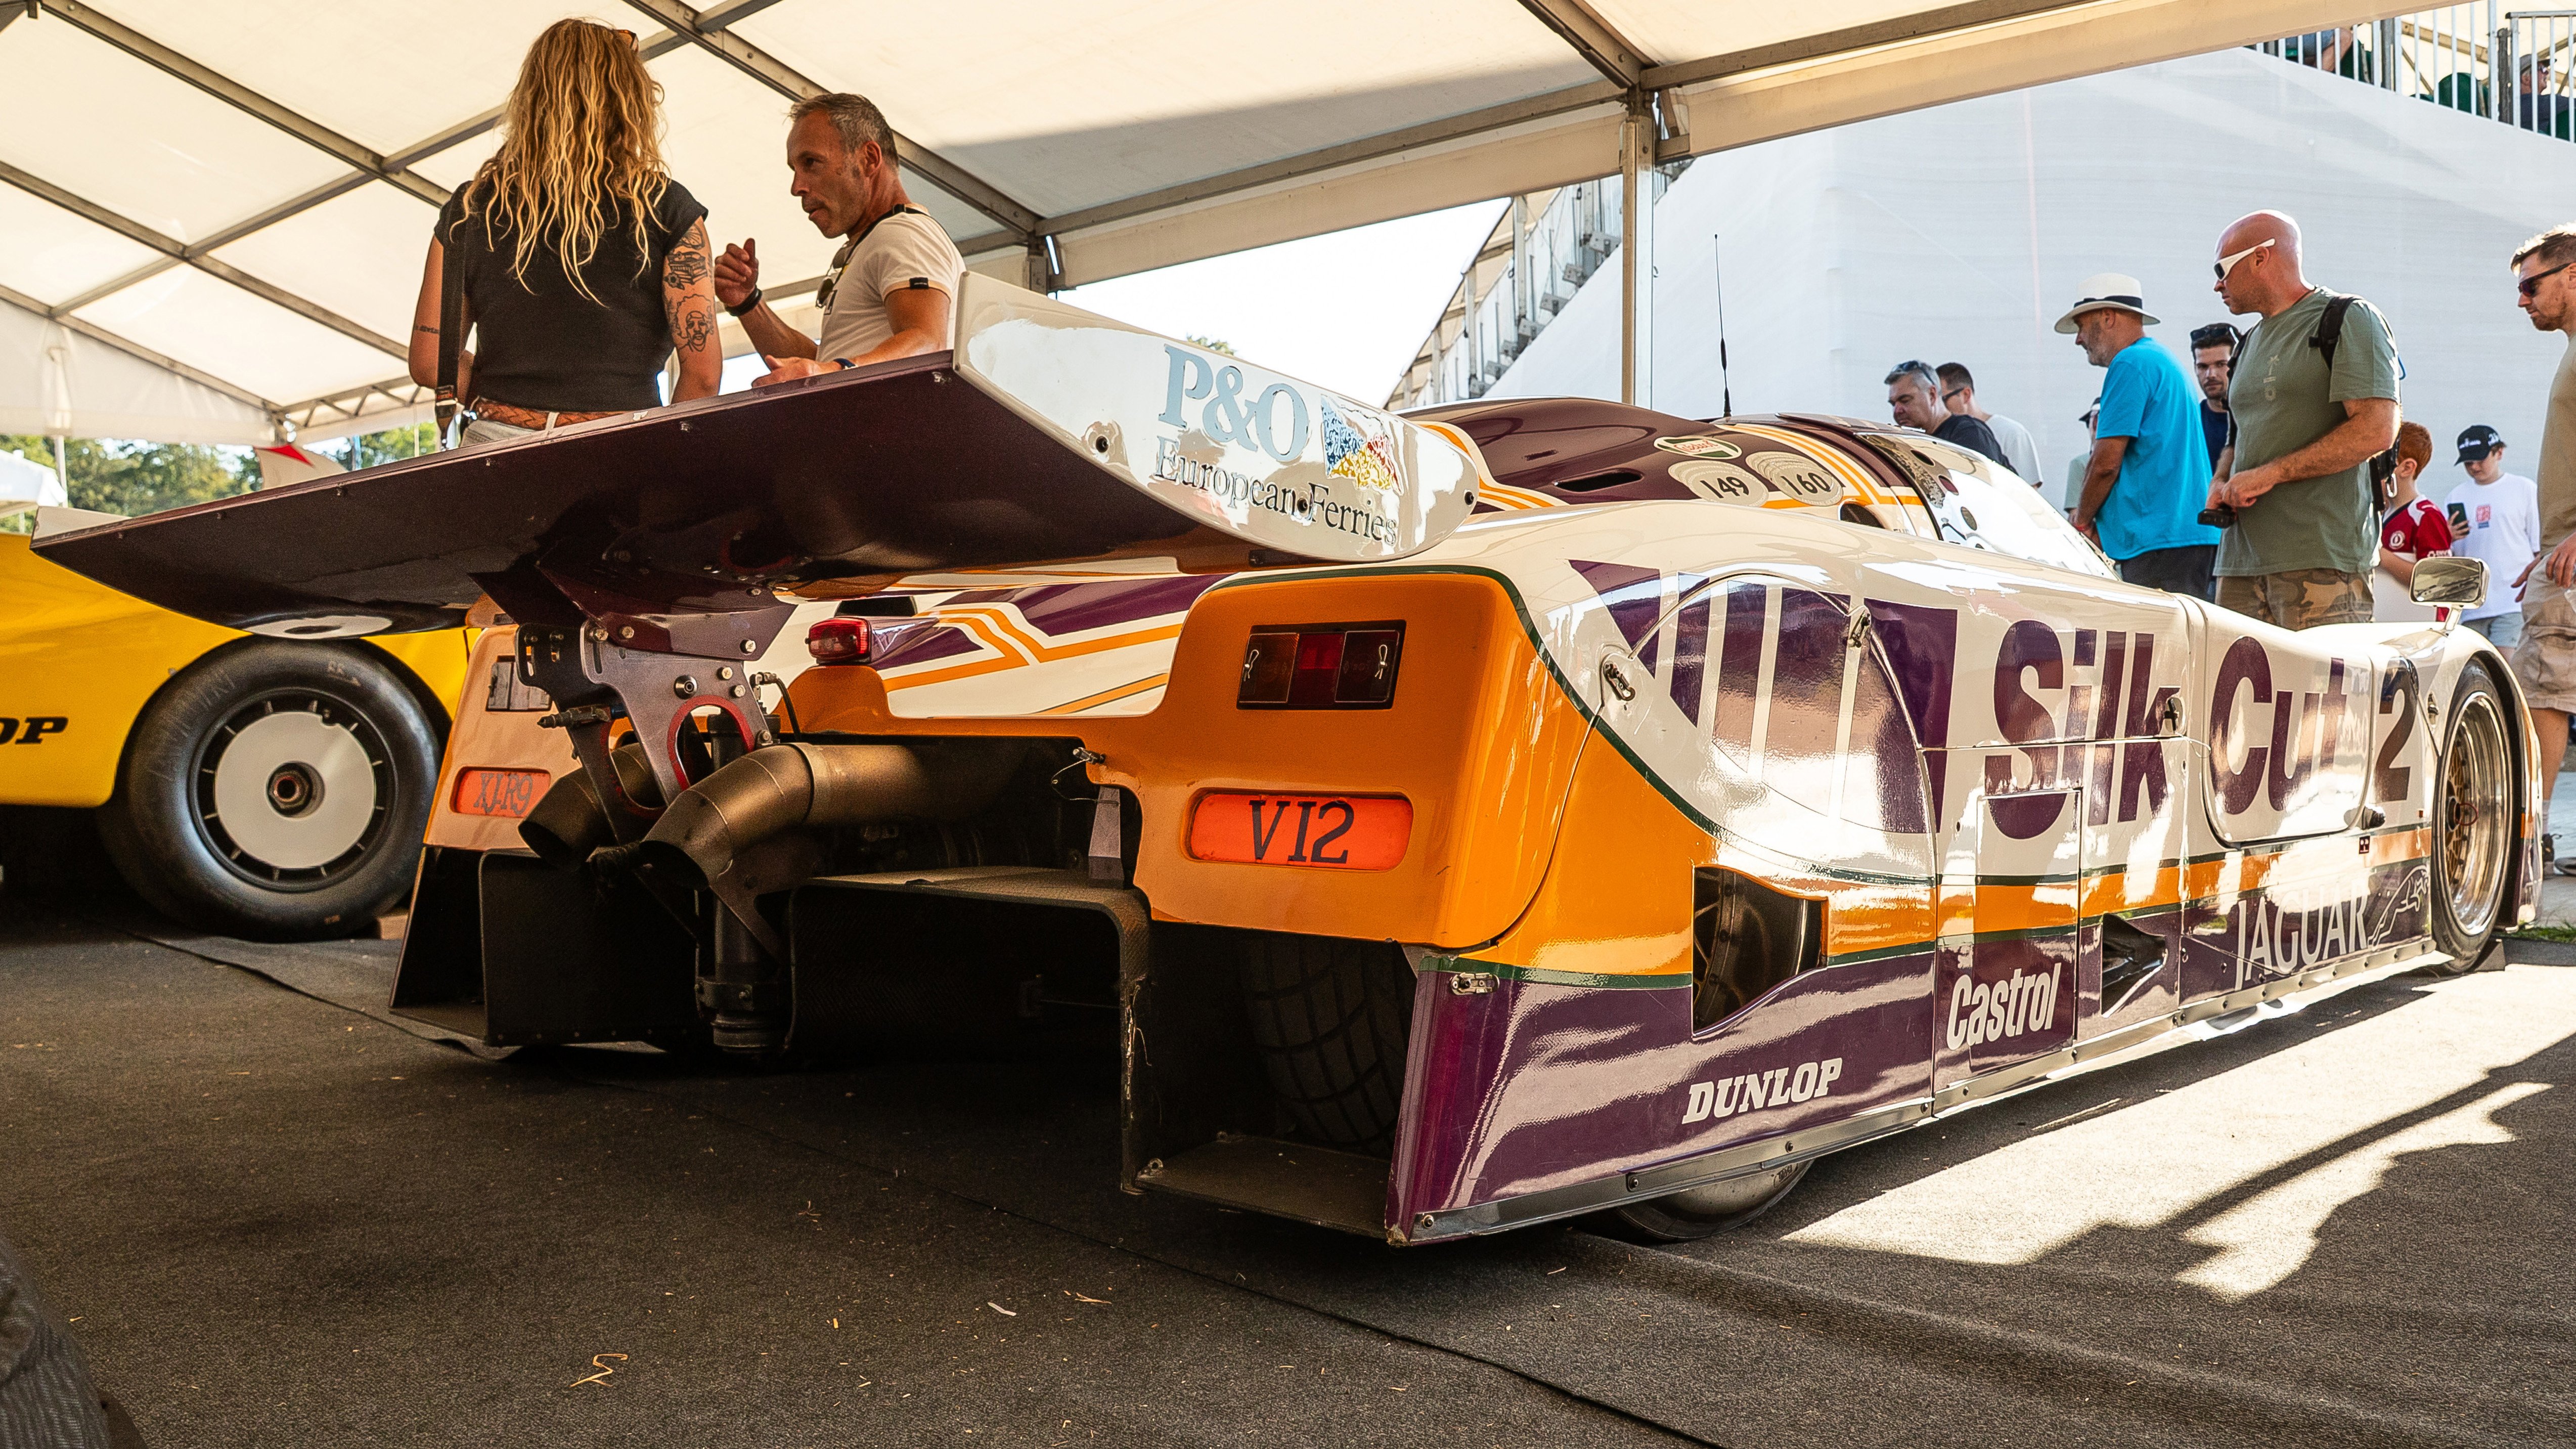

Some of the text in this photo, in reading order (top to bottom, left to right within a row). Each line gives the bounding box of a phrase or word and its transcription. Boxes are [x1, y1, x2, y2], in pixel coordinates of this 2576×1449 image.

[1159, 344, 1309, 461] P&O
[1155, 436, 1397, 545] European Ferries
[1700, 476, 1749, 499] 149
[1780, 472, 1831, 495] 160
[1985, 620, 2347, 840] Silk Cut
[2374, 655, 2417, 801] 2
[2234, 881, 2369, 991] JAGUAR
[1946, 963, 2061, 1050] Castrol
[1682, 1058, 1842, 1124] DUNLOP
